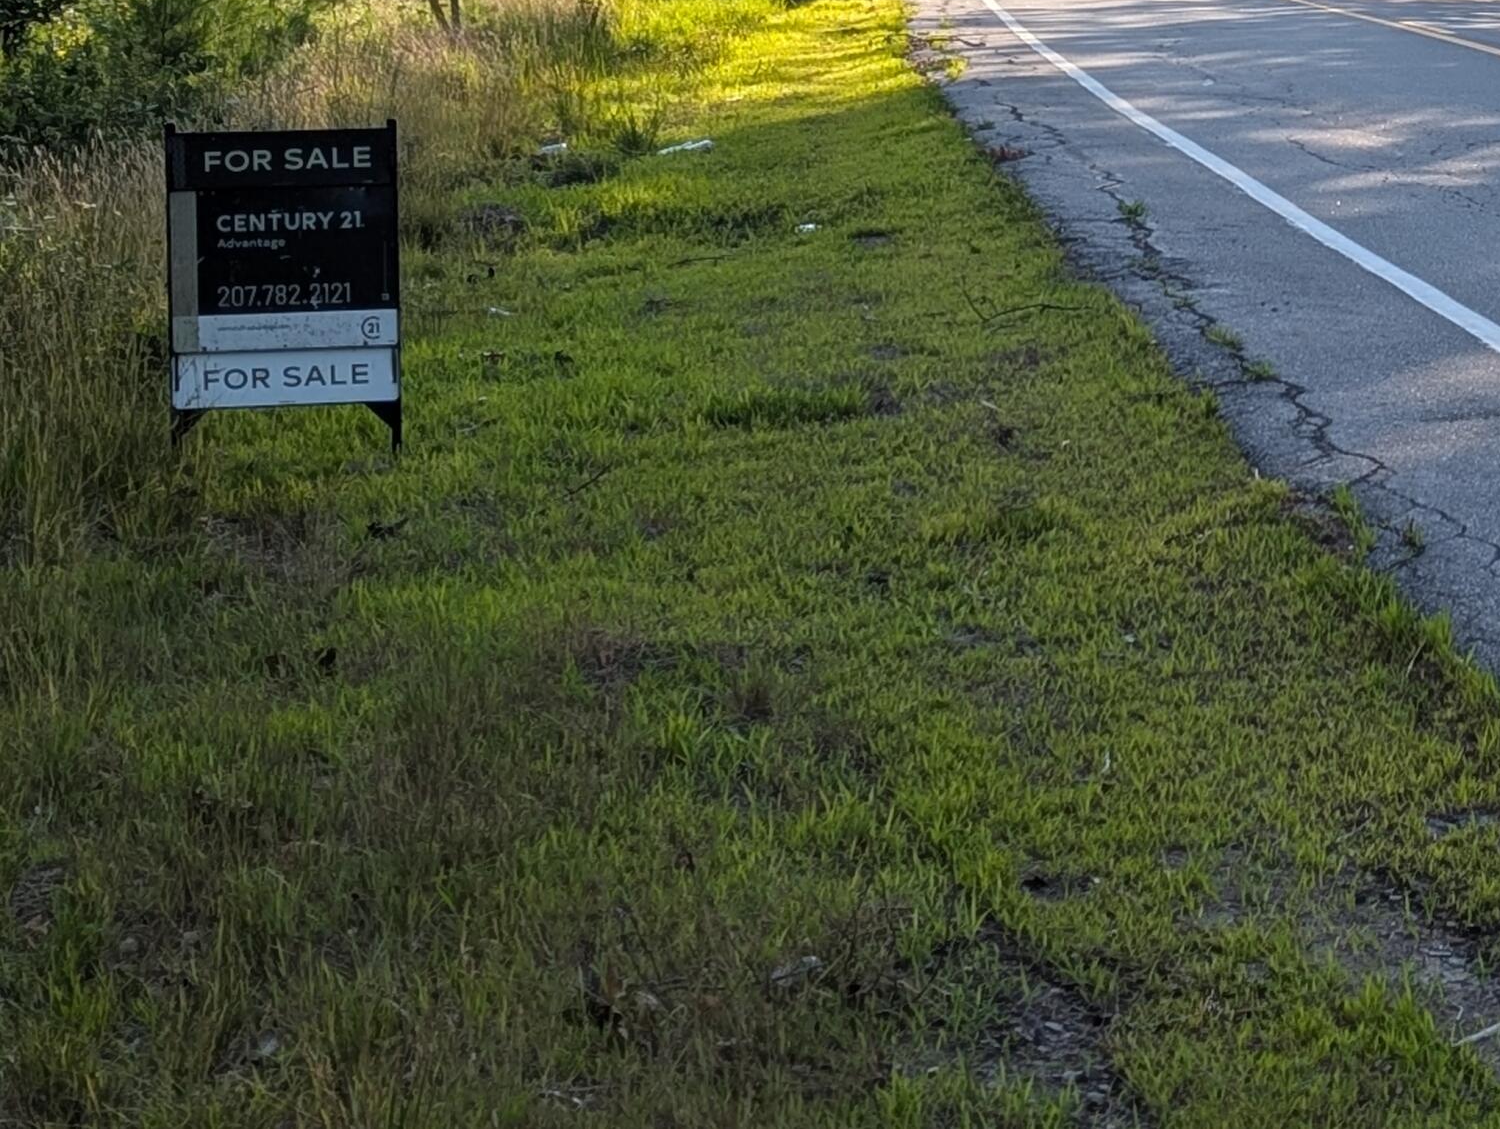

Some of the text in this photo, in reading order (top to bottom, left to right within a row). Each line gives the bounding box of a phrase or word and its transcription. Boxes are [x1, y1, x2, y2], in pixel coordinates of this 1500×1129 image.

[204, 146, 372, 173] FOR SALE
[216, 211, 334, 232] CENTURY
[217, 236, 286, 251] Advantage
[217, 282, 351, 308] 207.782.2121
[203, 363, 369, 391] FOR SALE
